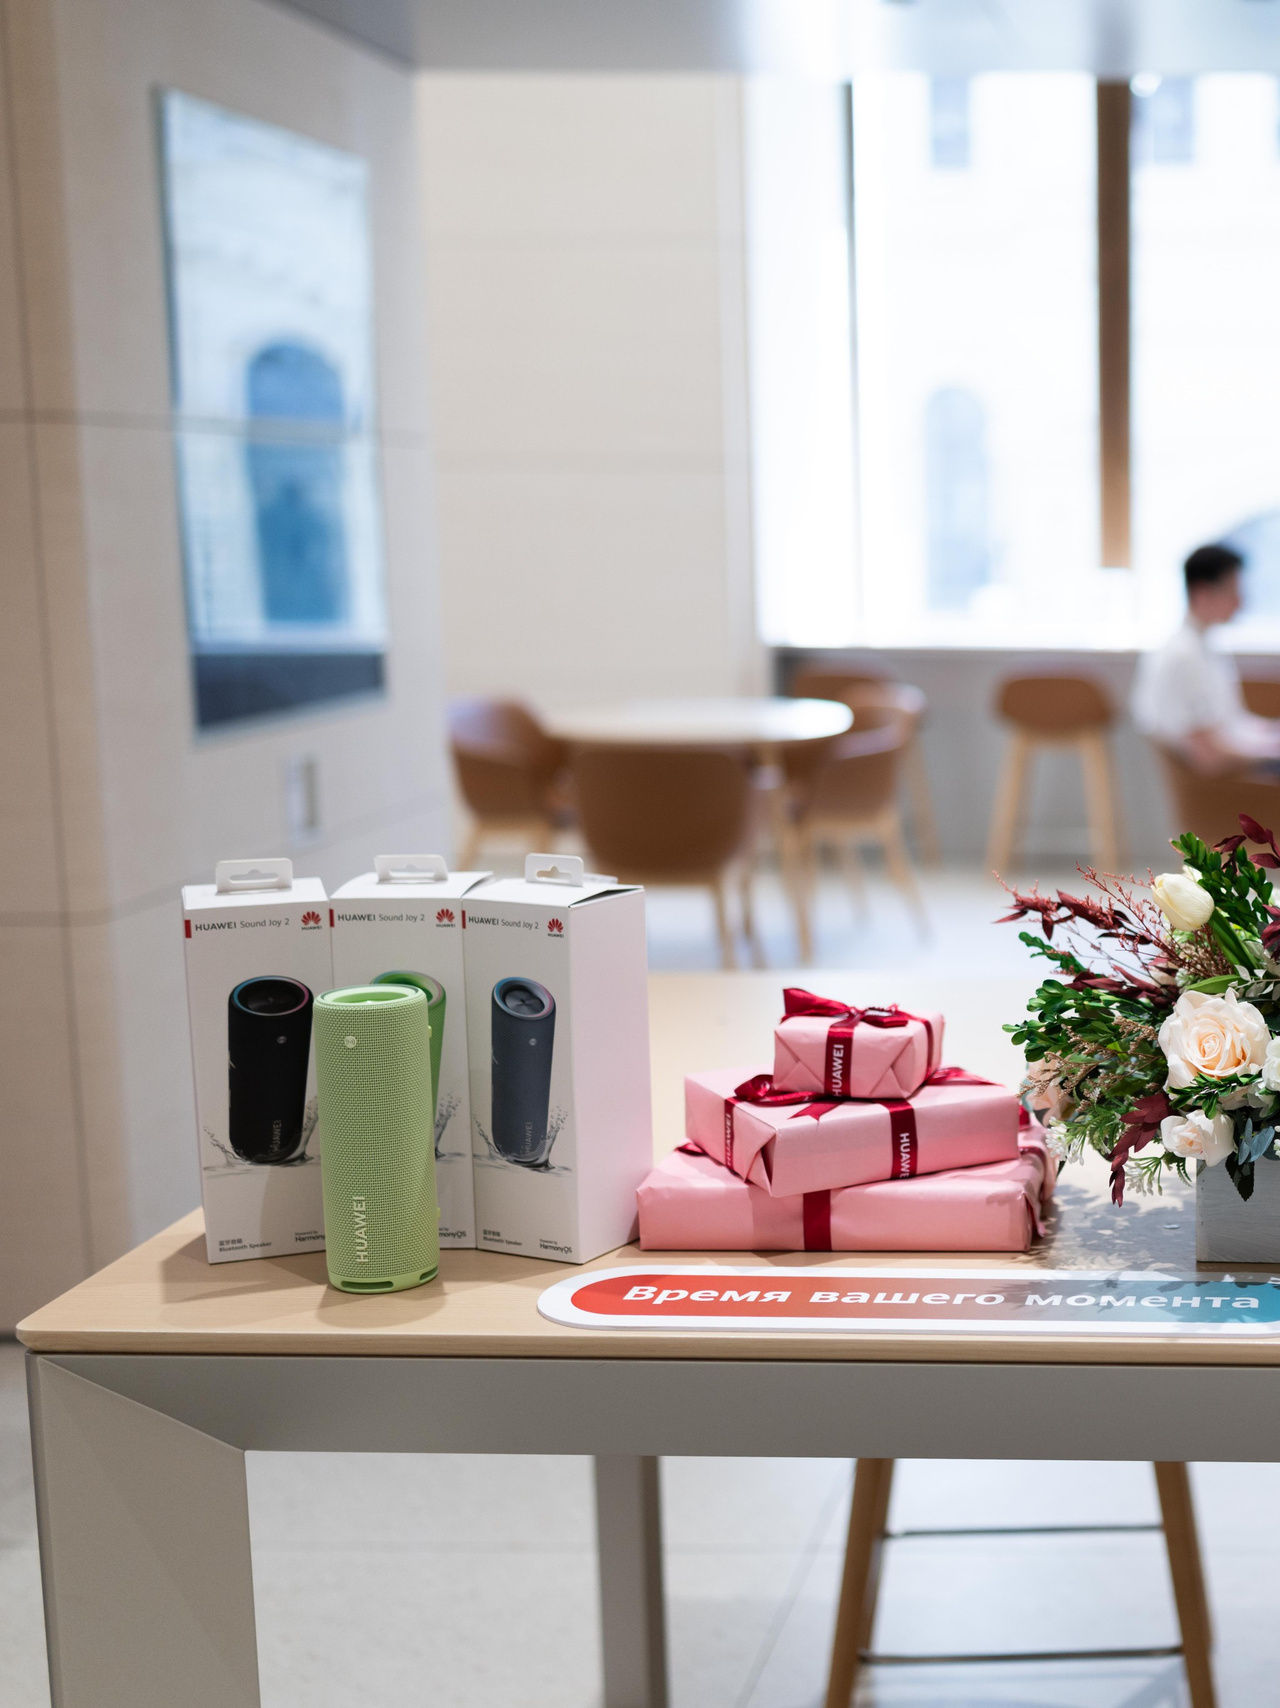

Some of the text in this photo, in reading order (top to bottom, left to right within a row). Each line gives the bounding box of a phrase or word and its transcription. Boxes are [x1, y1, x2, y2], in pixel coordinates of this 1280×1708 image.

[195, 918, 290, 931] HUAWEI Sound Joy 2
[405, 914, 418, 923] Joy
[468, 916, 539, 930] HUAWEI Sound Joy 2
[832, 1044, 844, 1097] HUAWEI
[900, 1132, 911, 1178] HUAWE
[295, 1234, 326, 1242] Harmony
[353, 1196, 369, 1263] HUAWEI
[623, 1286, 1260, 1308] Время вашего момента
